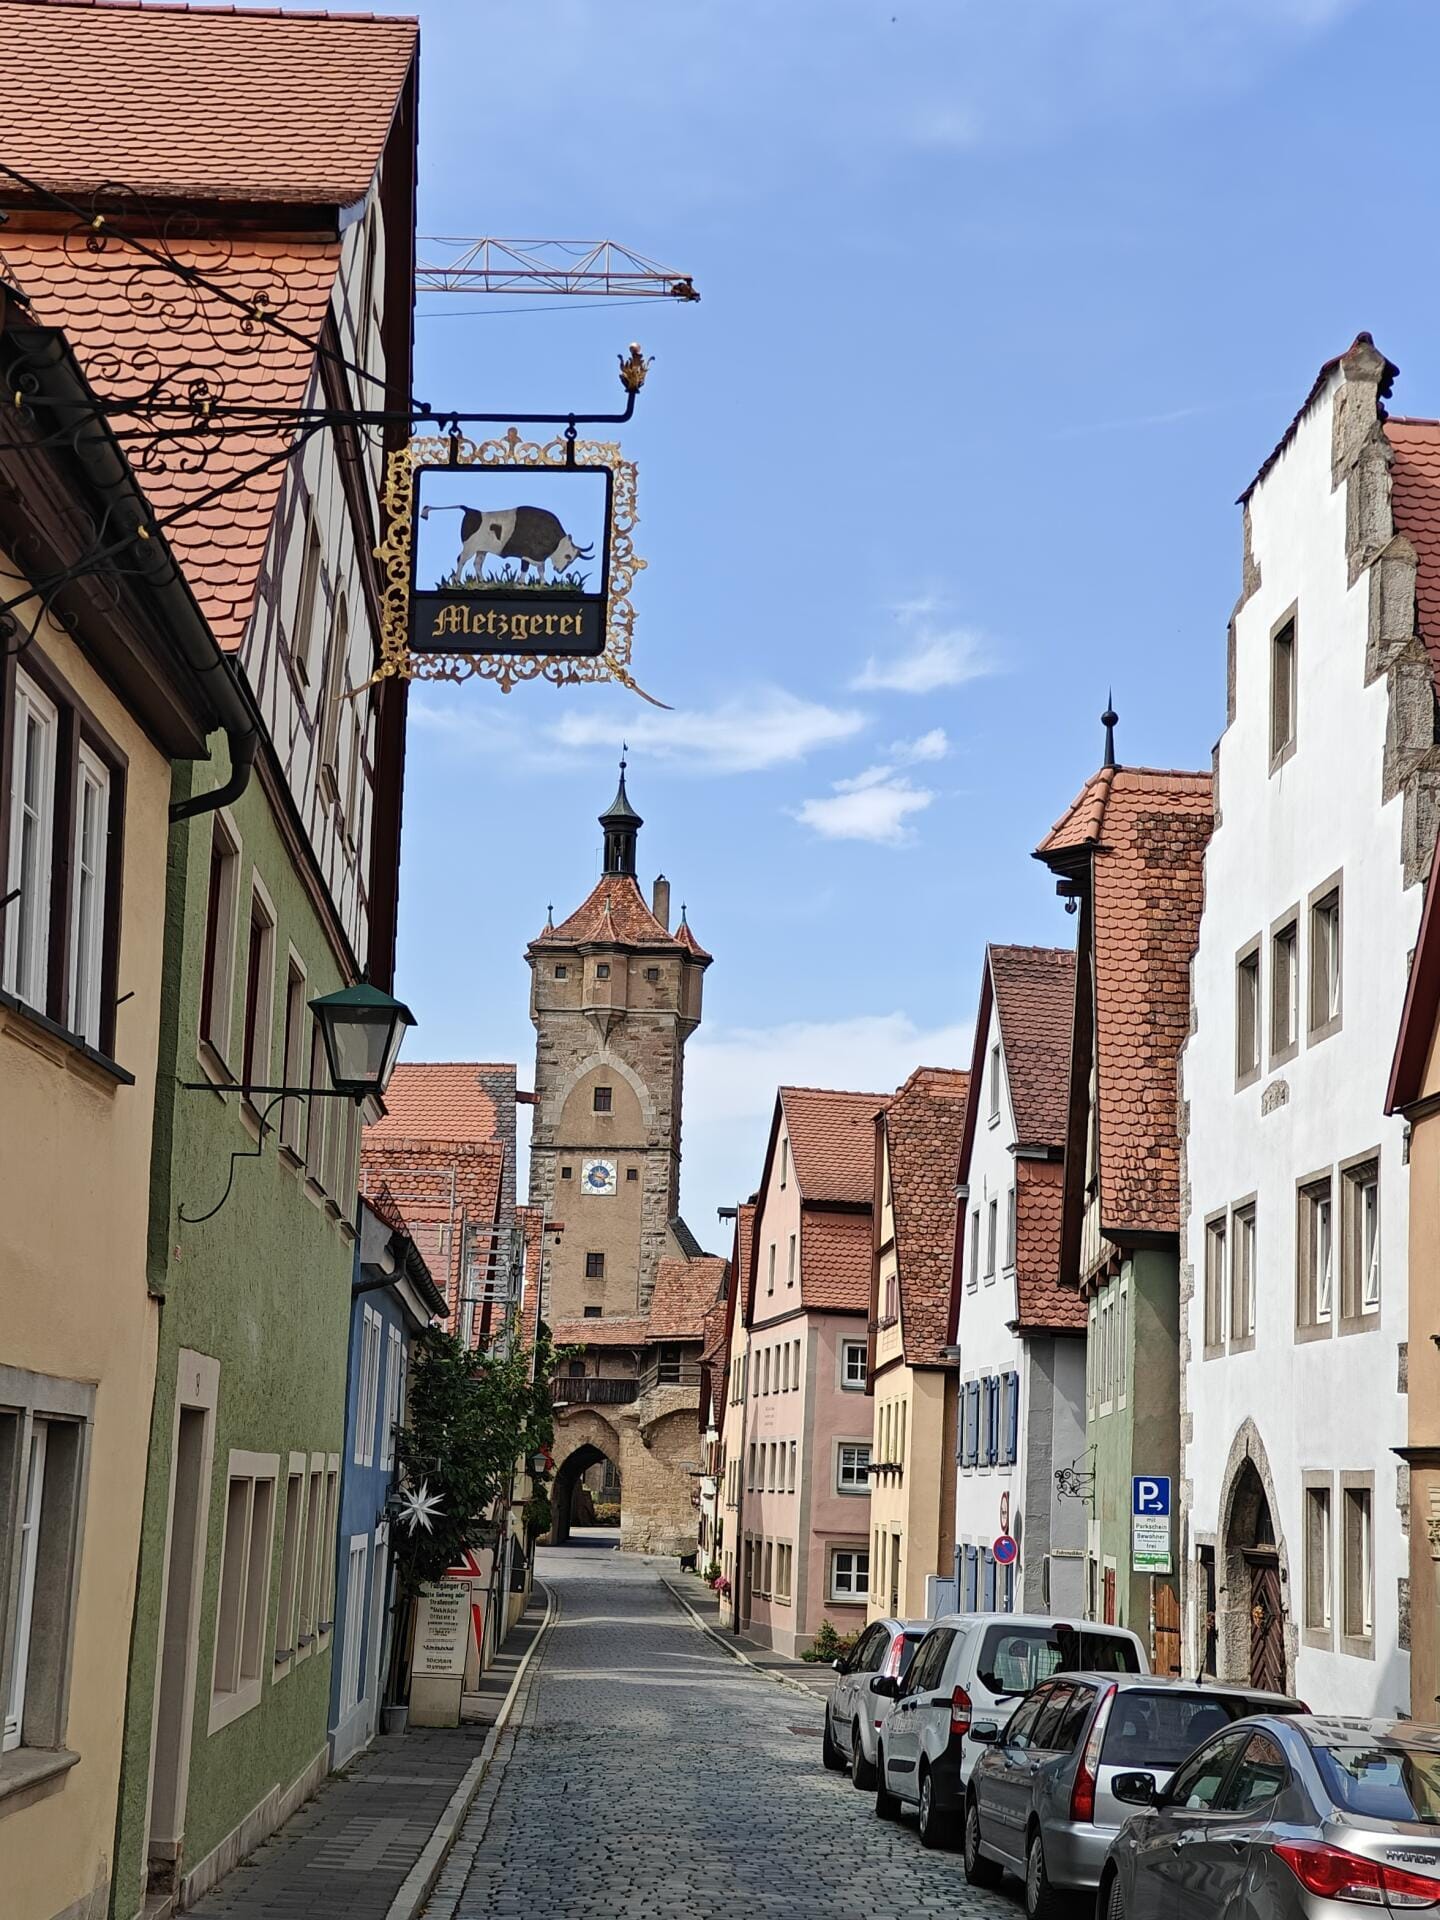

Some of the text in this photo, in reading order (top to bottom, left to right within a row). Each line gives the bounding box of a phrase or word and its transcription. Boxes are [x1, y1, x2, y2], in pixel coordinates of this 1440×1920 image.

[432, 604, 583, 640] Metzgerei
[1139, 1481, 1159, 1511] P
[1136, 1532, 1165, 1540] Bewohner
[1386, 1850, 1436, 1865] HYUNDAI
